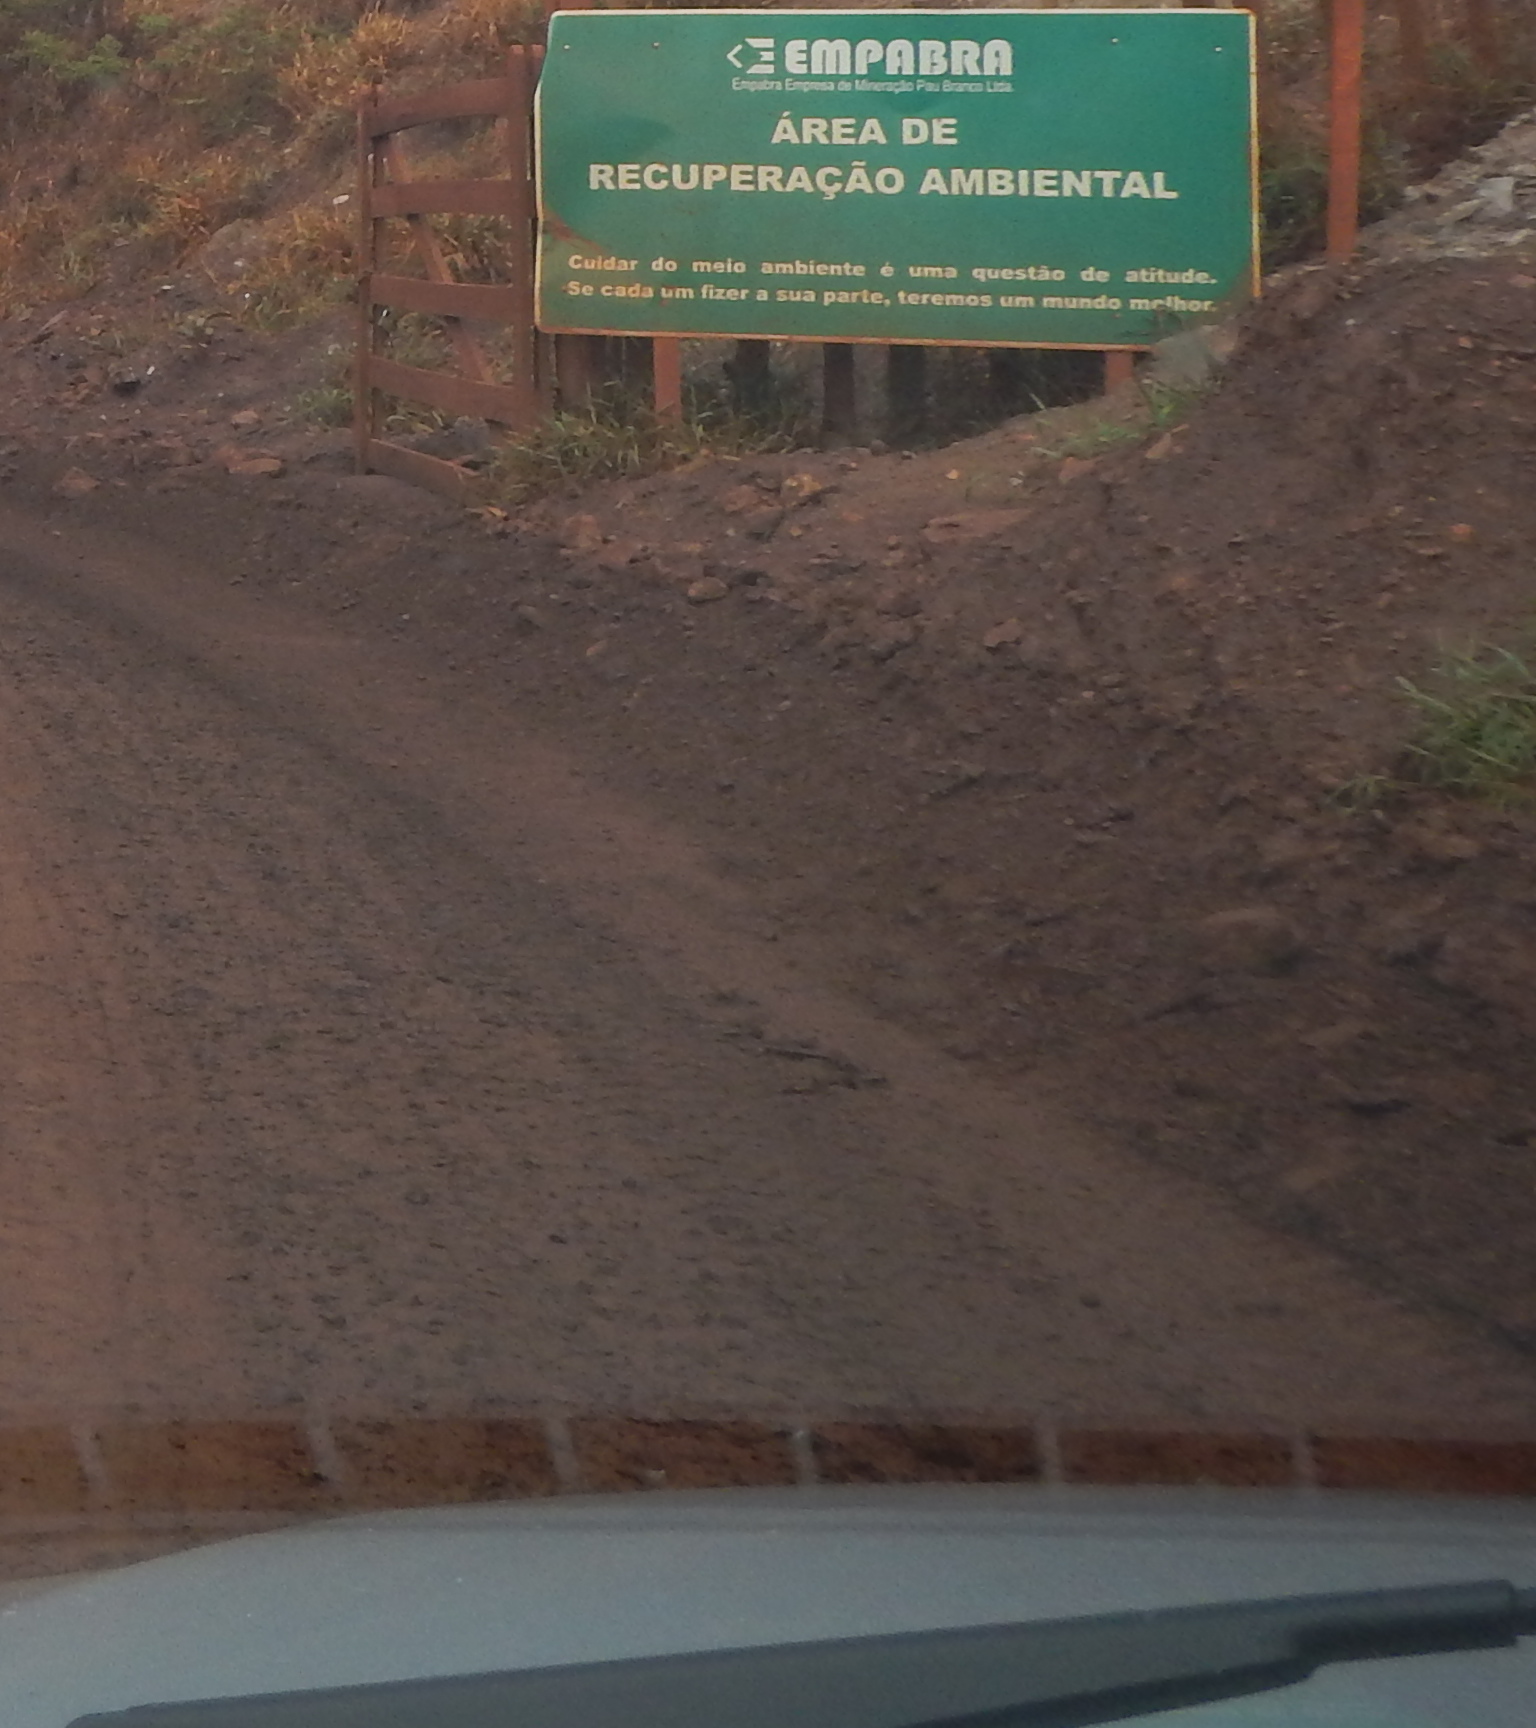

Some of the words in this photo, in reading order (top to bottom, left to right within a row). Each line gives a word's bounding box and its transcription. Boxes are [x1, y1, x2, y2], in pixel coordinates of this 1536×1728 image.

[785, 39, 1013, 76] EMPABRA
[732, 77, 781, 92] Empabra
[785, 78, 834, 92] Empresa
[837, 79, 852, 91] de
[917, 79, 940, 91] Pau
[771, 111, 887, 144] ÁREA
[902, 118, 958, 145] DE
[589, 161, 904, 200] RECUPERAÇÃO
[919, 169, 1179, 199] AMBIENTAL
[568, 254, 638, 271] Cuidar
[651, 257, 677, 272] do
[692, 258, 745, 273] meio
[761, 261, 866, 277] ambiente
[880, 262, 894, 277] é
[909, 266, 957, 278] uma
[972, 266, 1065, 282] questão
[1080, 267, 1110, 282] de
[1125, 268, 1217, 284] atitude.
[568, 281, 593, 296] Se
[601, 282, 653, 298] cada
[660, 287, 694, 299] um
[701, 284, 749, 301] fizer
[756, 289, 768, 301] a
[776, 290, 815, 302] sua
[823, 290, 891, 306] parte,
[898, 291, 992, 307] teremos
[1000, 295, 1035, 308] um
[1042, 295, 1122, 310] mundo
